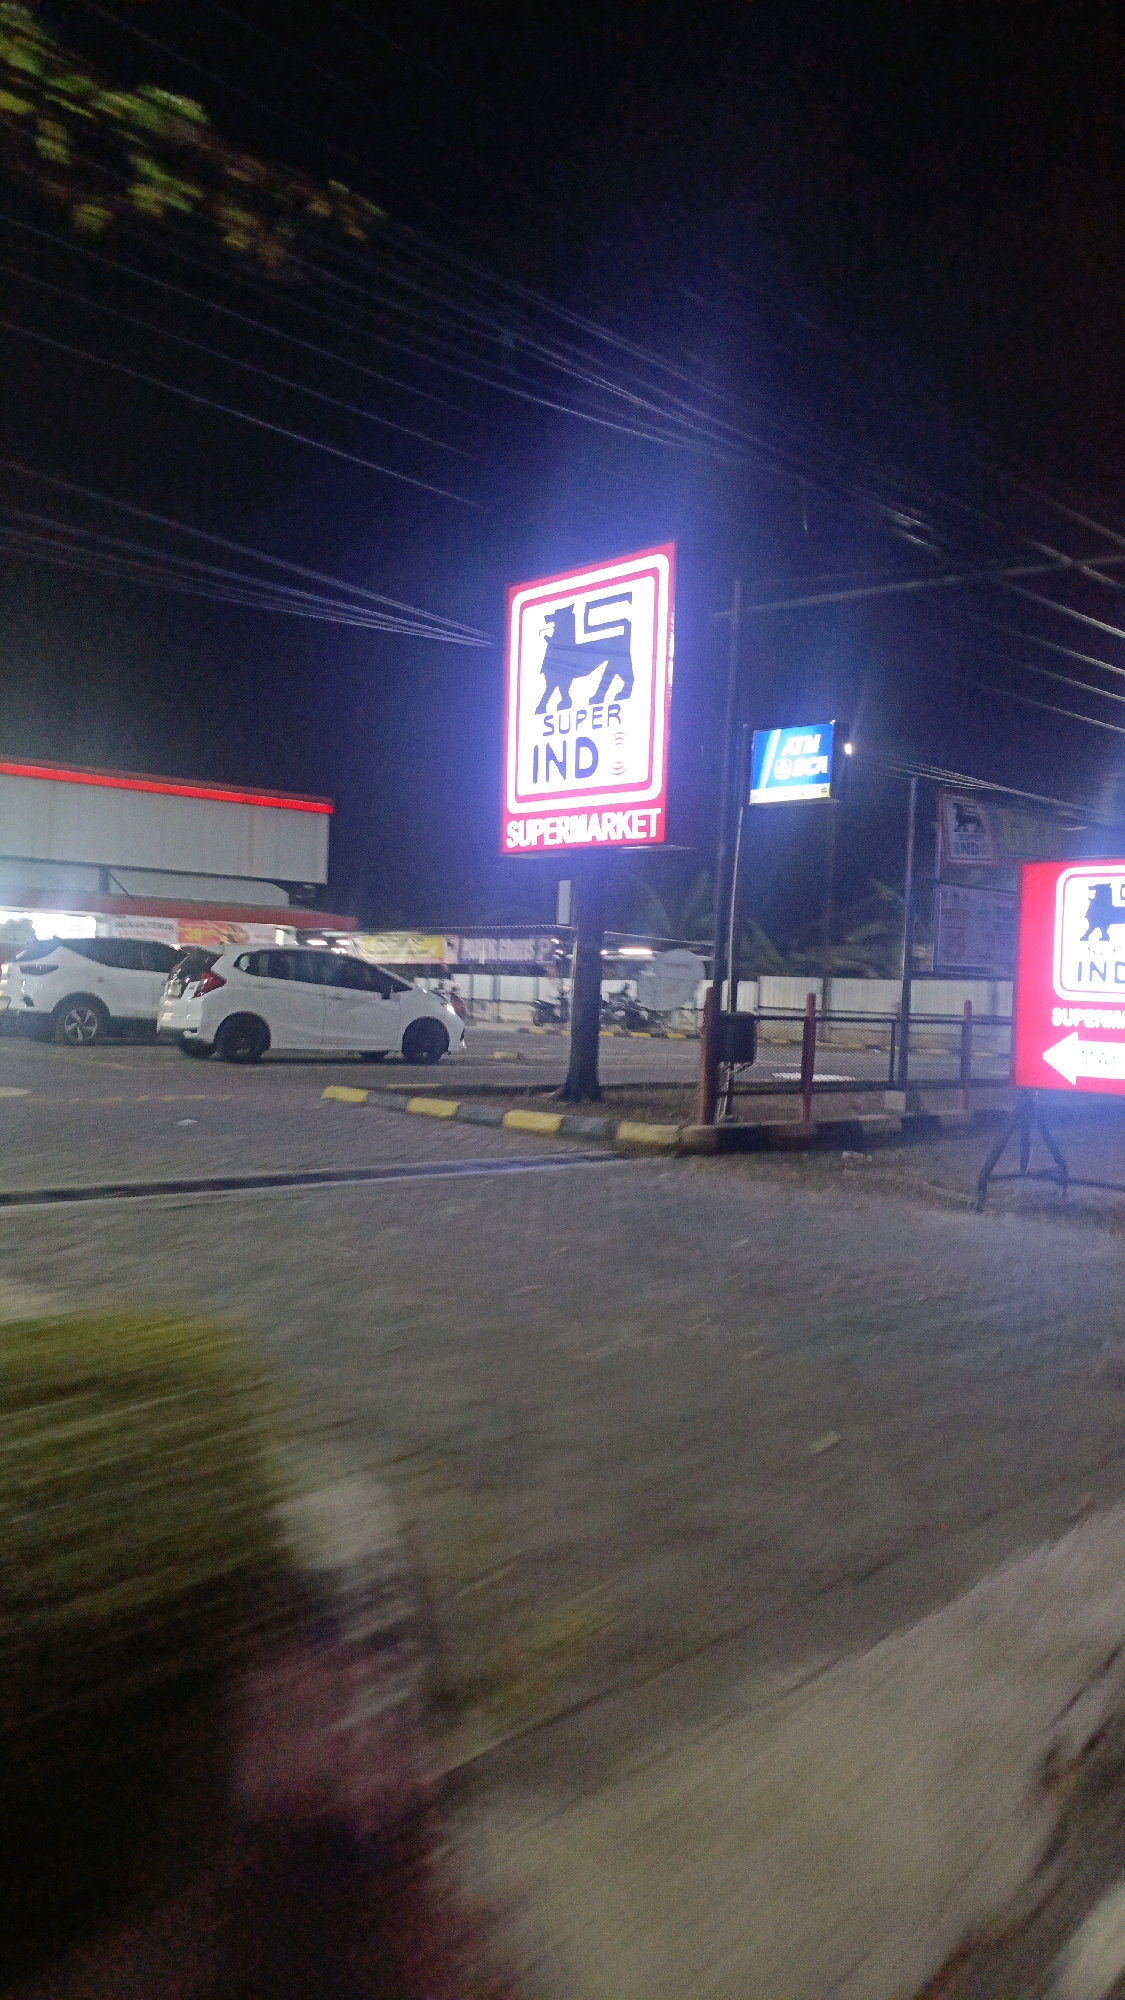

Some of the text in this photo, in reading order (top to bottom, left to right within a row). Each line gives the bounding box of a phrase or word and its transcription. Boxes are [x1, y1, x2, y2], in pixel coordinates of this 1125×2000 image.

[543, 703, 622, 737] SUPER
[780, 734, 822, 757] ATM
[791, 755, 828, 777] BCA
[506, 807, 662, 849] SUPERMARKET
